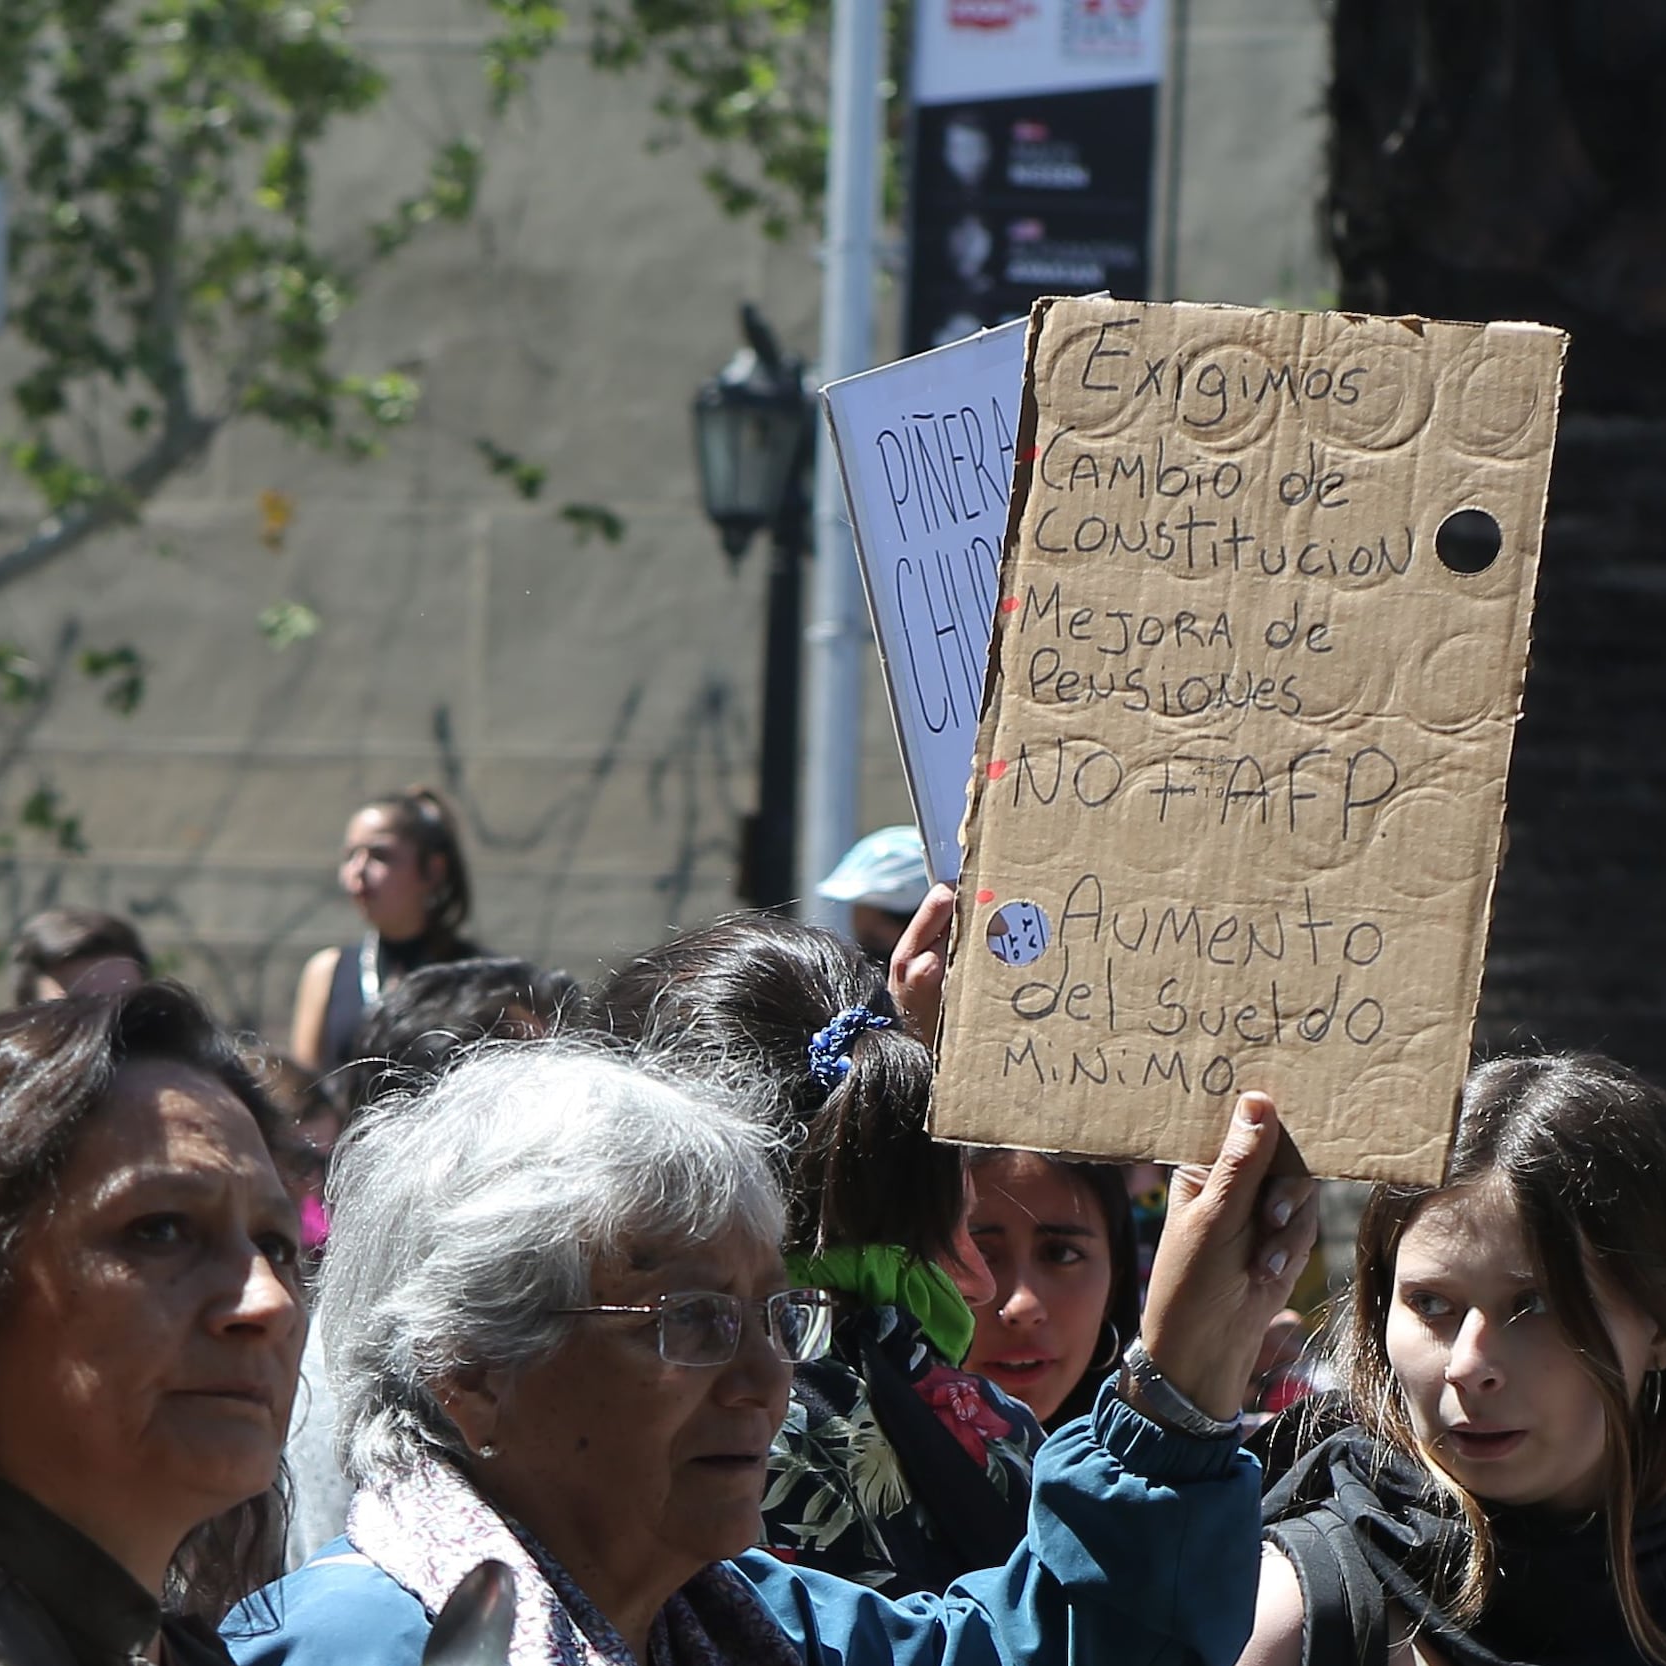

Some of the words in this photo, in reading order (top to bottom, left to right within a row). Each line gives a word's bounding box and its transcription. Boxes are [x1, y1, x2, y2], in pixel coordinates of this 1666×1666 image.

[1279, 441, 1349, 508] de
[1265, 601, 1333, 653] de
[1013, 738, 1124, 808] NO
[1011, 945, 1115, 1032] del
